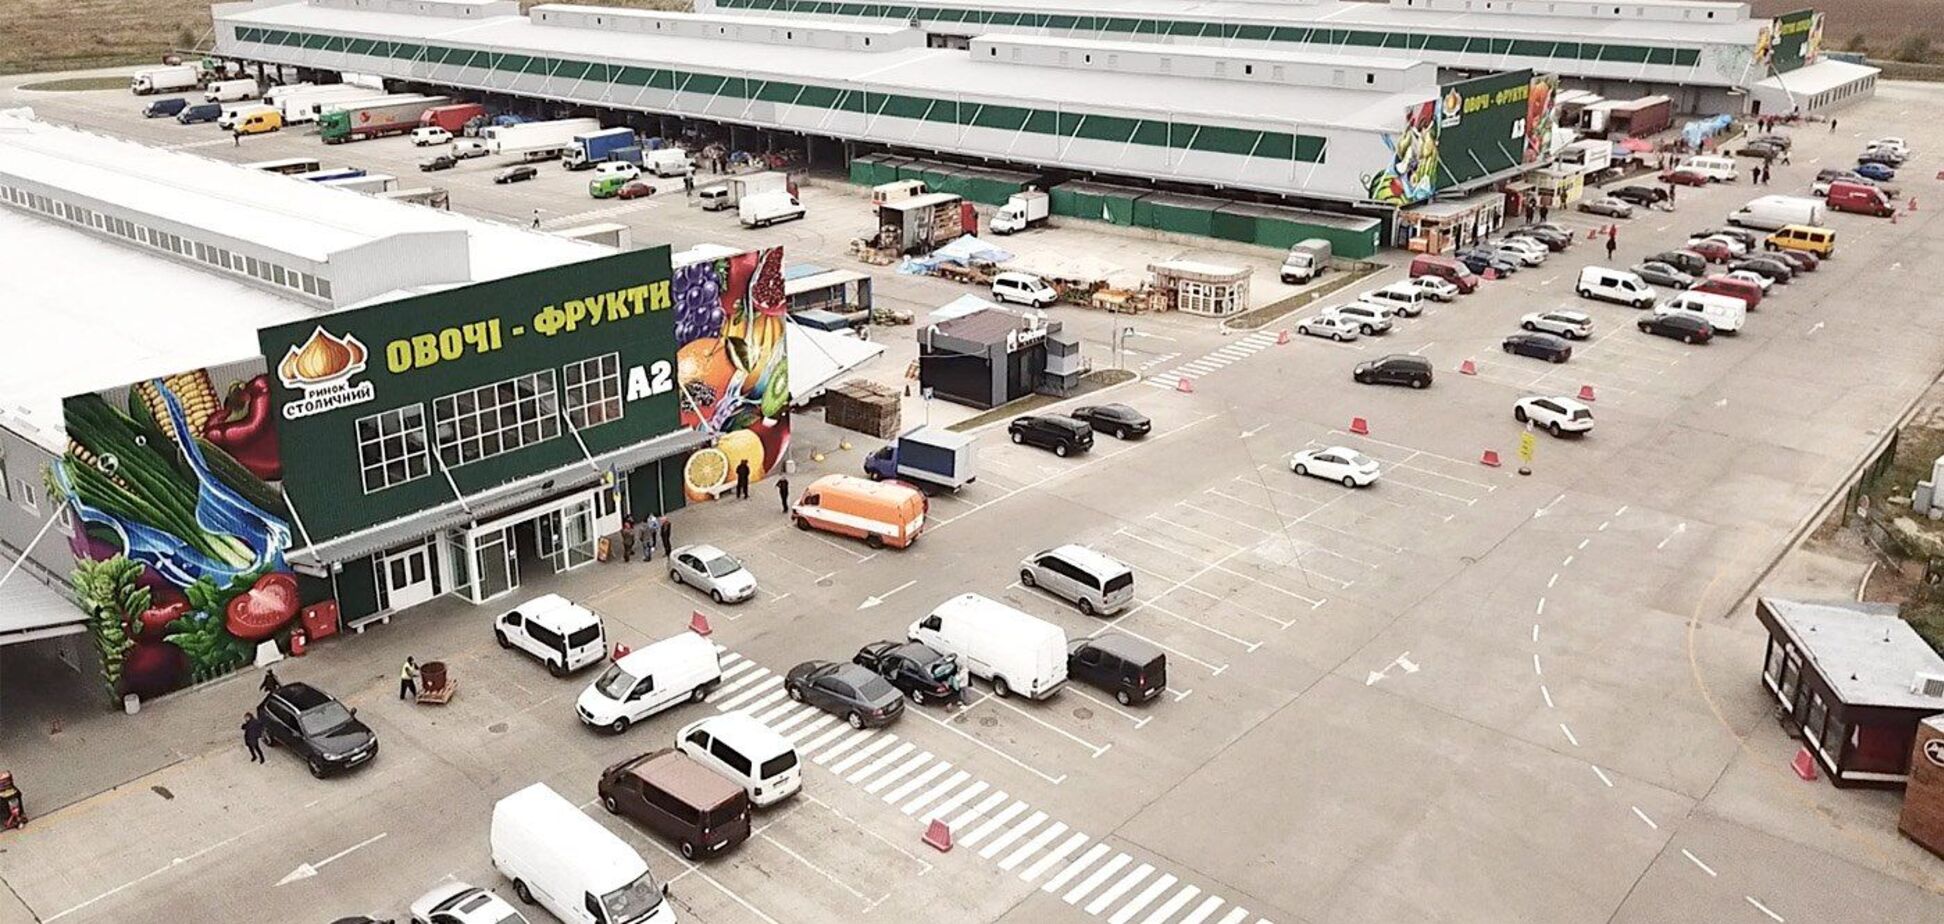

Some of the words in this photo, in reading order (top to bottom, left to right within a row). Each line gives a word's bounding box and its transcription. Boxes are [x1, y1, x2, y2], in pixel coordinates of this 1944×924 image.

[385, 318, 503, 374] ОВОЧІ
[533, 279, 672, 337] ФРУКТИ
[286, 384, 371, 416] СТОЛИЧНИЙ
[308, 383, 346, 399] РИНОК
